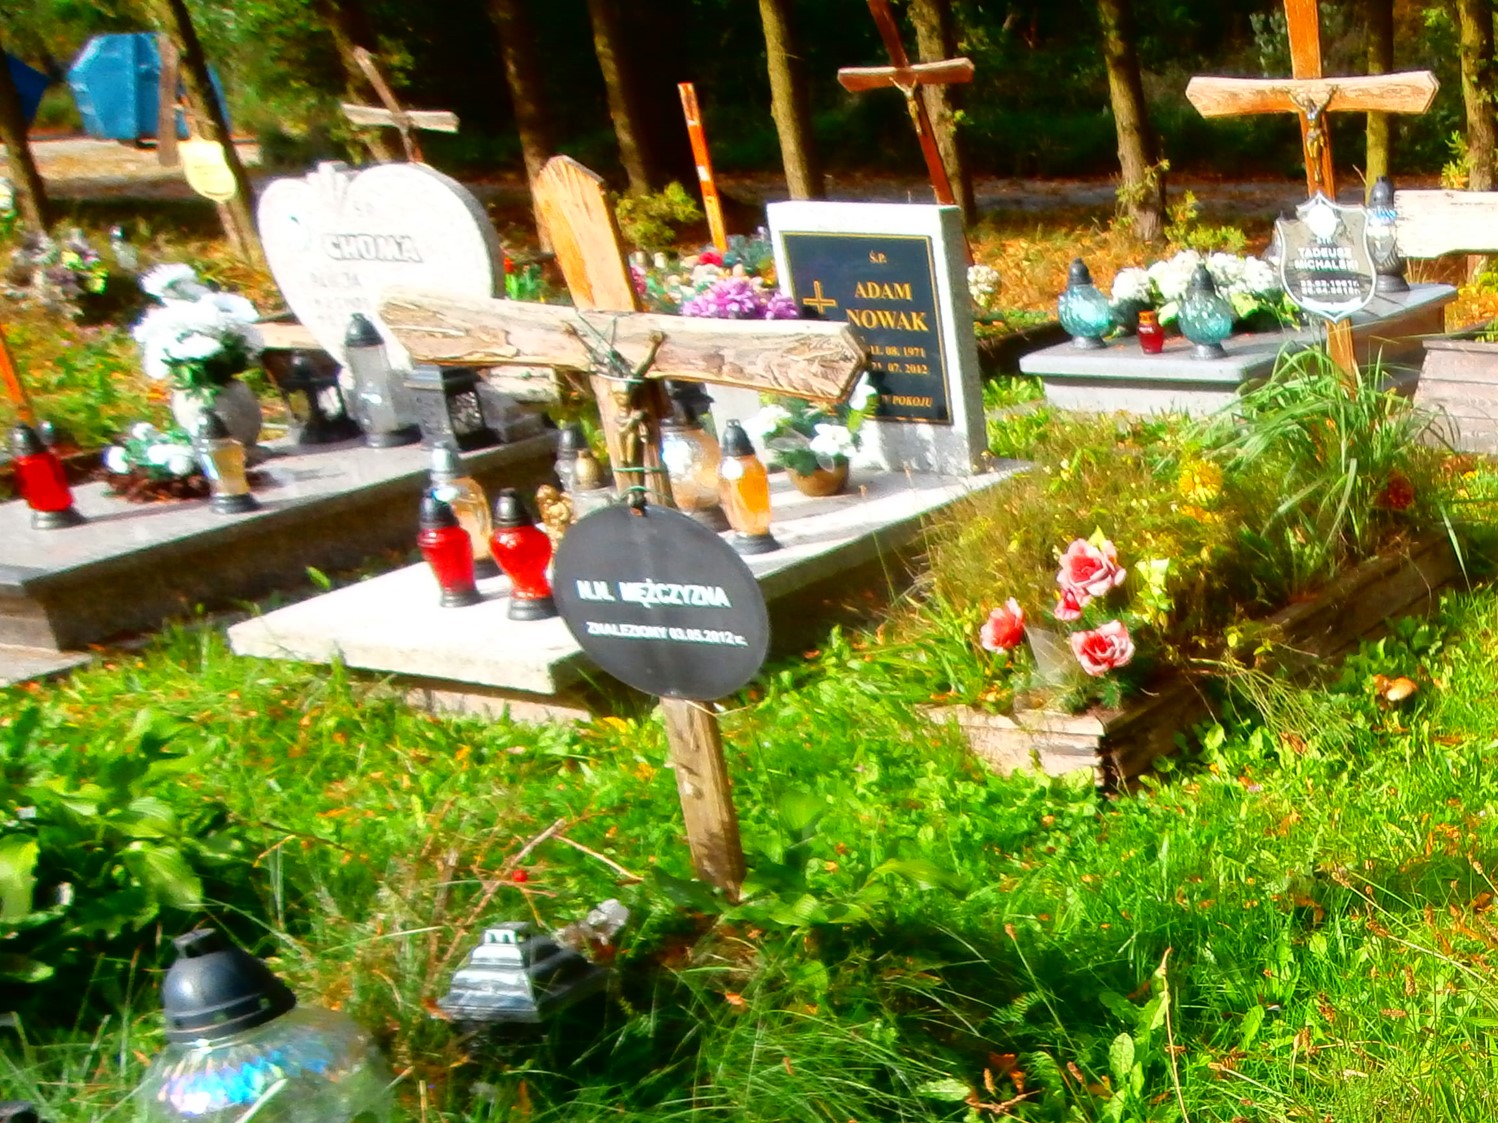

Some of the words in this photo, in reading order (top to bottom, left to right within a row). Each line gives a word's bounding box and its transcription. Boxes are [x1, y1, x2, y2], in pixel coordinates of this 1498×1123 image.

[321, 233, 424, 264] CHOMA
[1298, 247, 1352, 259] TADEUSZ
[1294, 259, 1359, 270] MICHALSKI
[854, 281, 912, 301] ADAM
[846, 309, 929, 332] NOWAK
[892, 395, 933, 408] POKOJU
[618, 578, 732, 609] MĘŻCZYZNA
[586, 622, 668, 639] ZNALEZIONY
